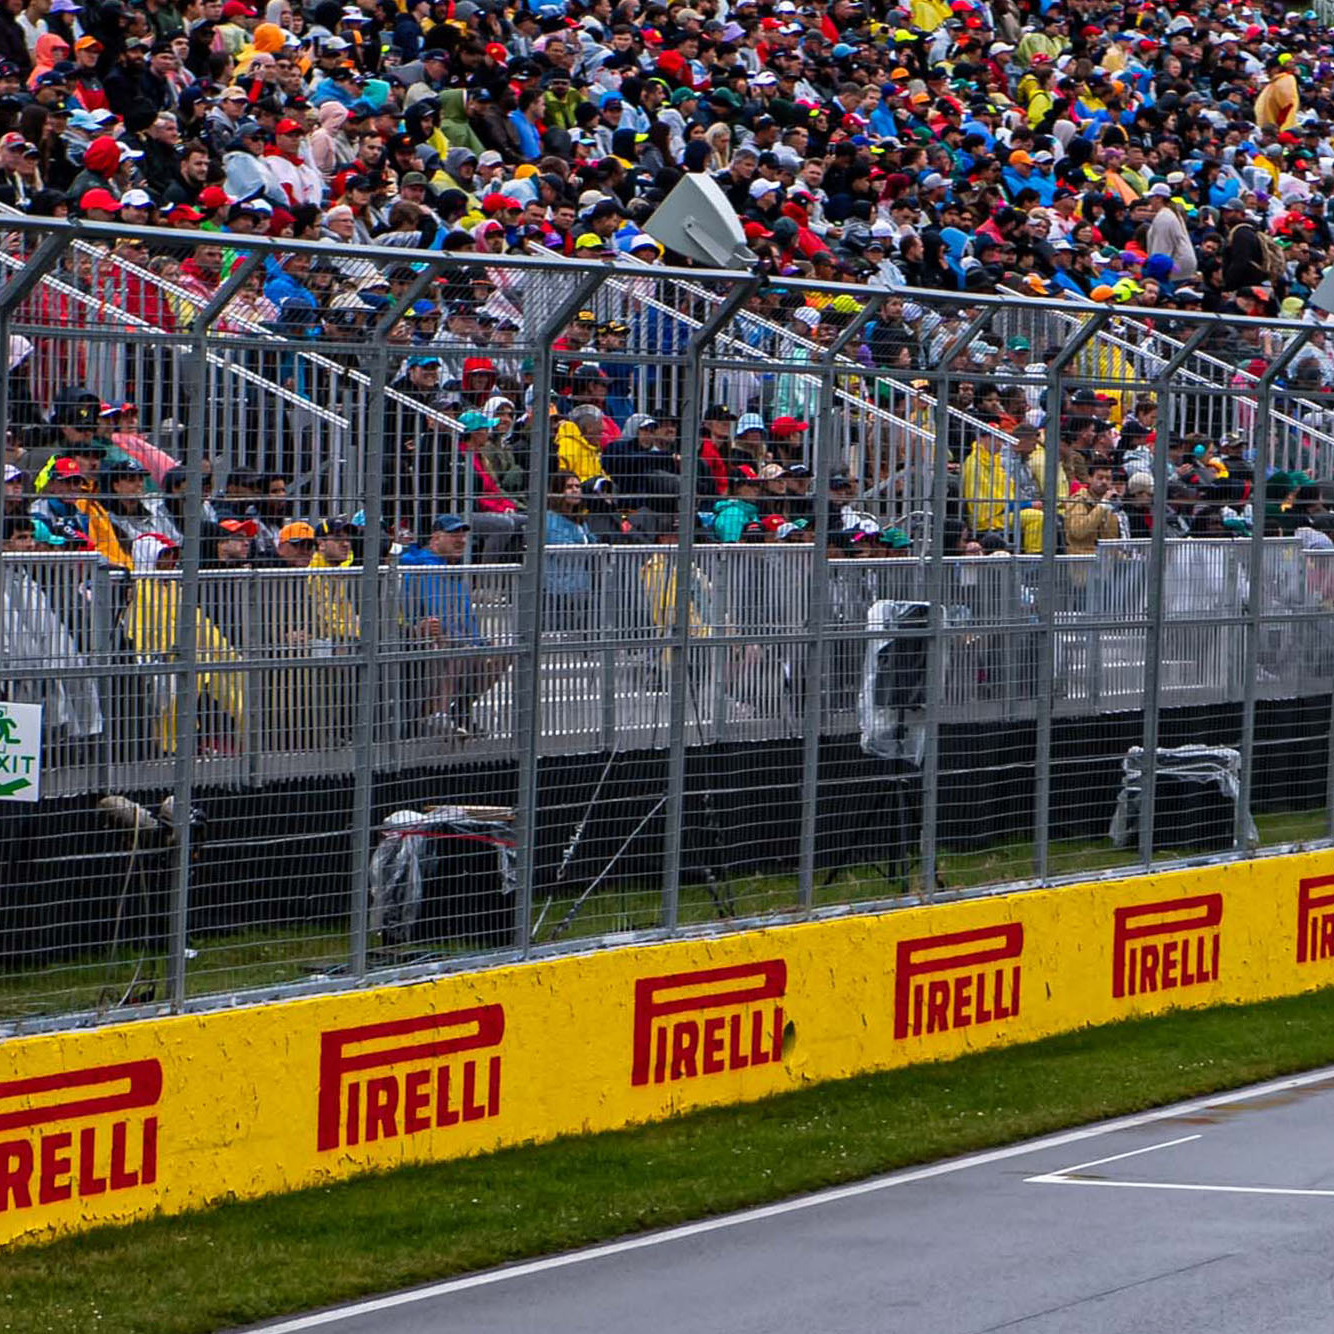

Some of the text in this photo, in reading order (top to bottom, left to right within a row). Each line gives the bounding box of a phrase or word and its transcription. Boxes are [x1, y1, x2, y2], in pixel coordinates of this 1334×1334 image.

[894, 923, 1024, 1040] PIRELLI
[1113, 893, 1223, 998] PIRELLI
[318, 1003, 505, 1152] PIRELLI
[631, 959, 787, 1086] PIRELLI
